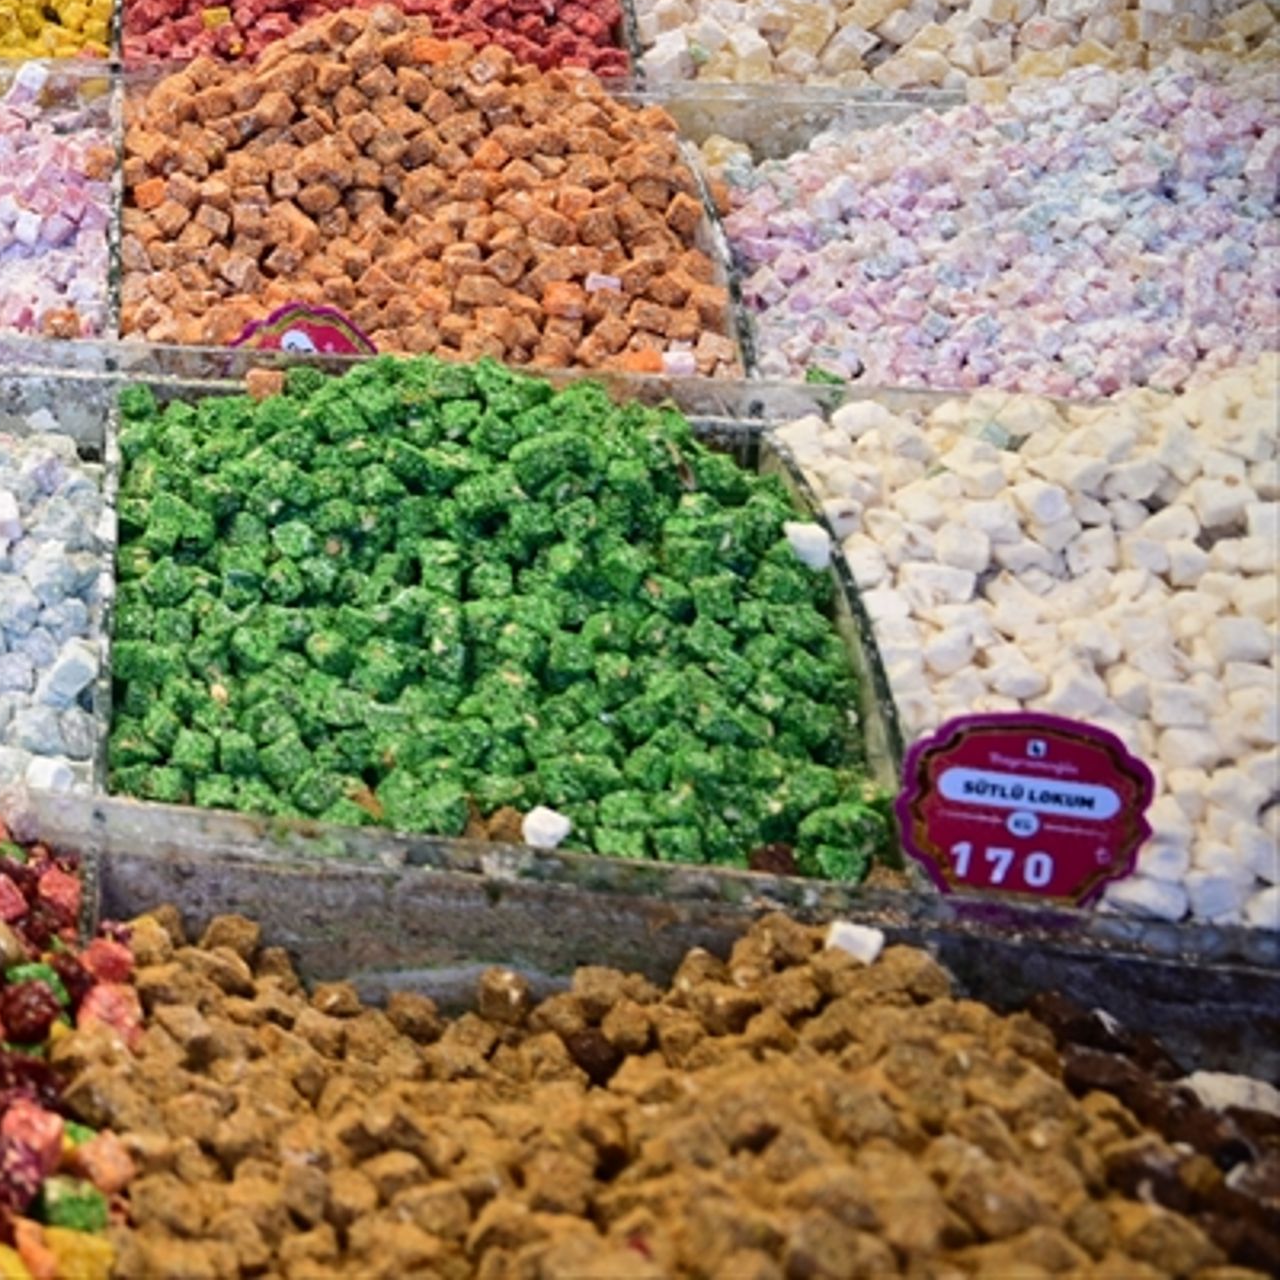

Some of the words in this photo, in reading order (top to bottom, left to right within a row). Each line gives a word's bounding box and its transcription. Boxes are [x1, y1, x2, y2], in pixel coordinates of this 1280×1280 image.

[963, 778, 1024, 801] SÜTLÜ
[1027, 790, 1096, 811] LOKUM
[949, 840, 1054, 887] 170
